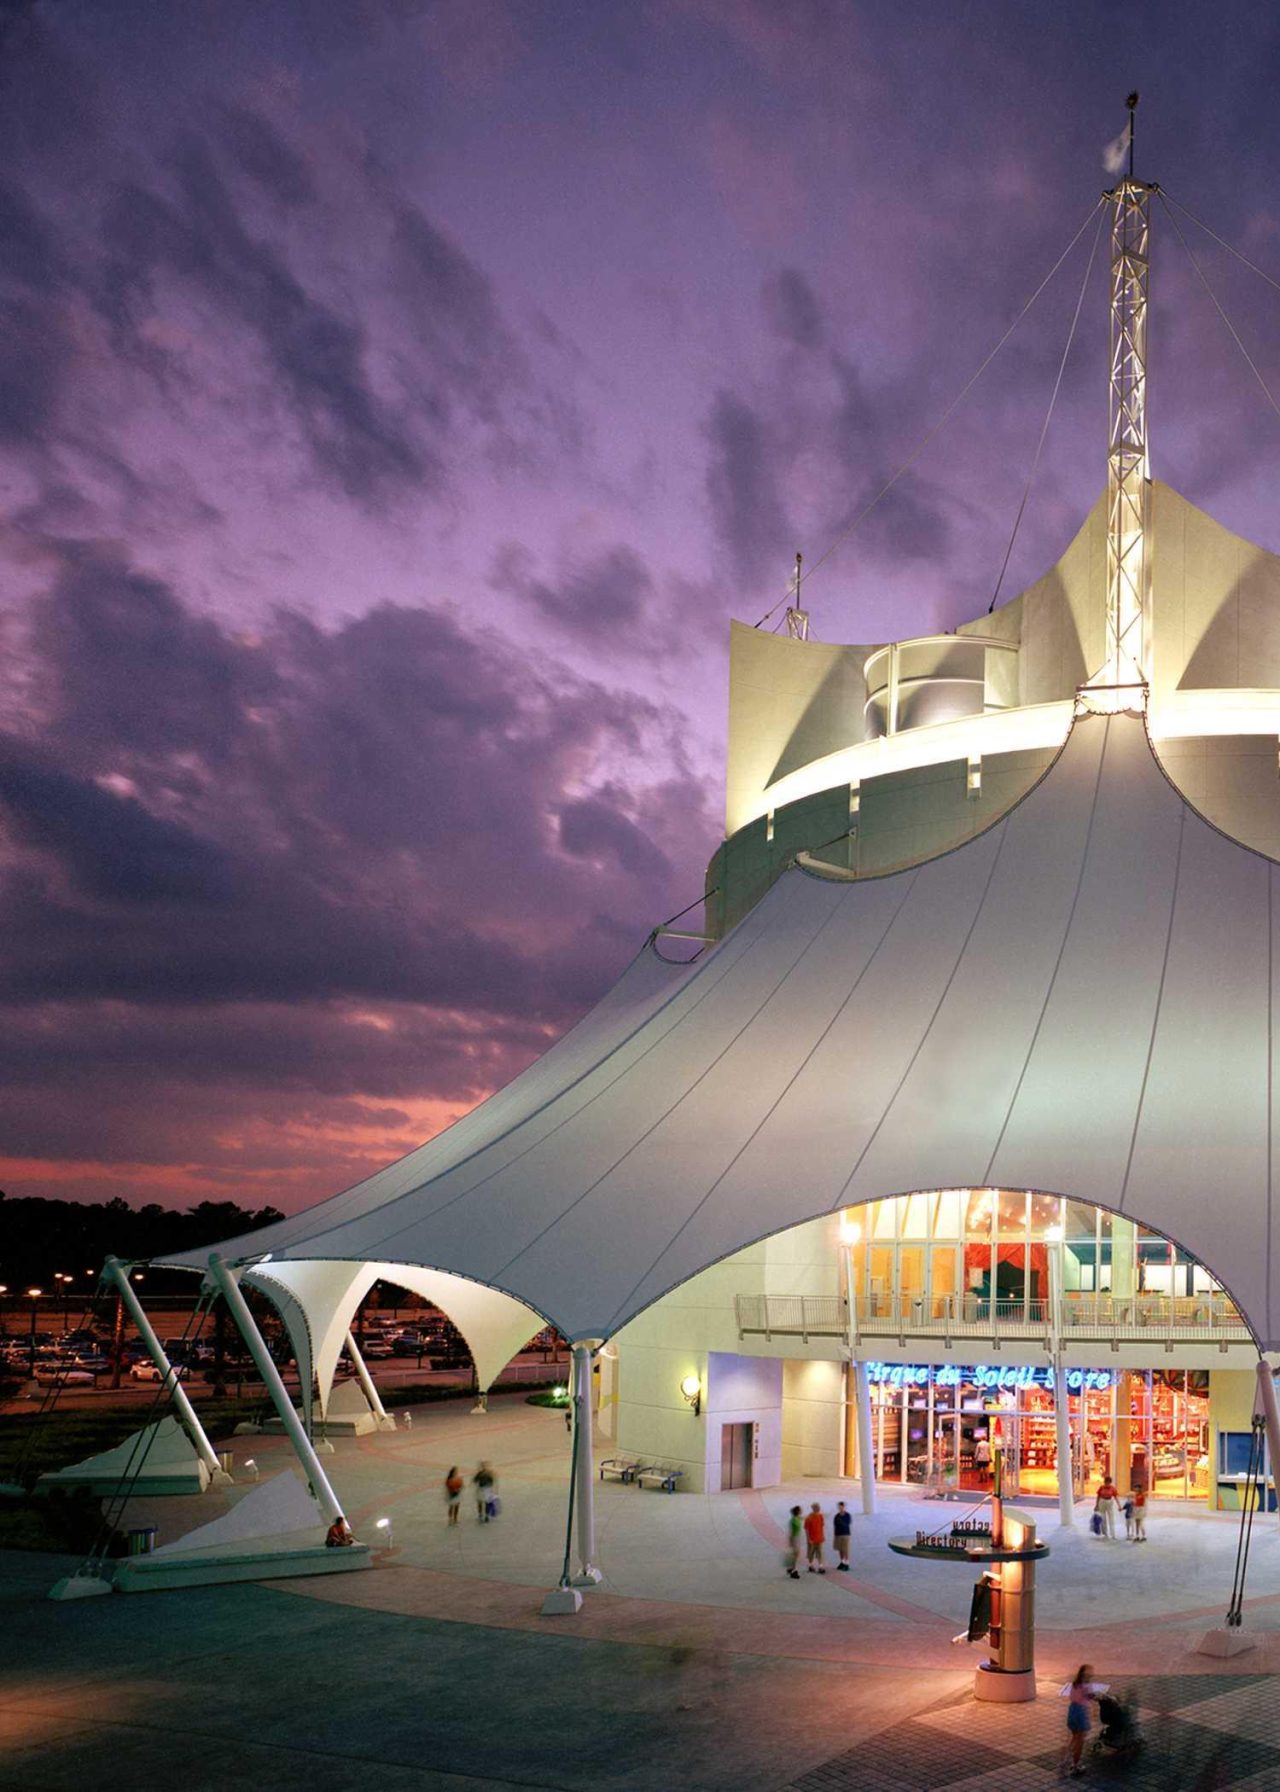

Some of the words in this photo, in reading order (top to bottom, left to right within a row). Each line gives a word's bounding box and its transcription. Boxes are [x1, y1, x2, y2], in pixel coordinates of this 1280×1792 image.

[935, 1364, 960, 1385] du
[972, 1365, 1034, 1387] Soleil
[1045, 1367, 1110, 1388] Sore
[915, 1530, 967, 1549] Directory
